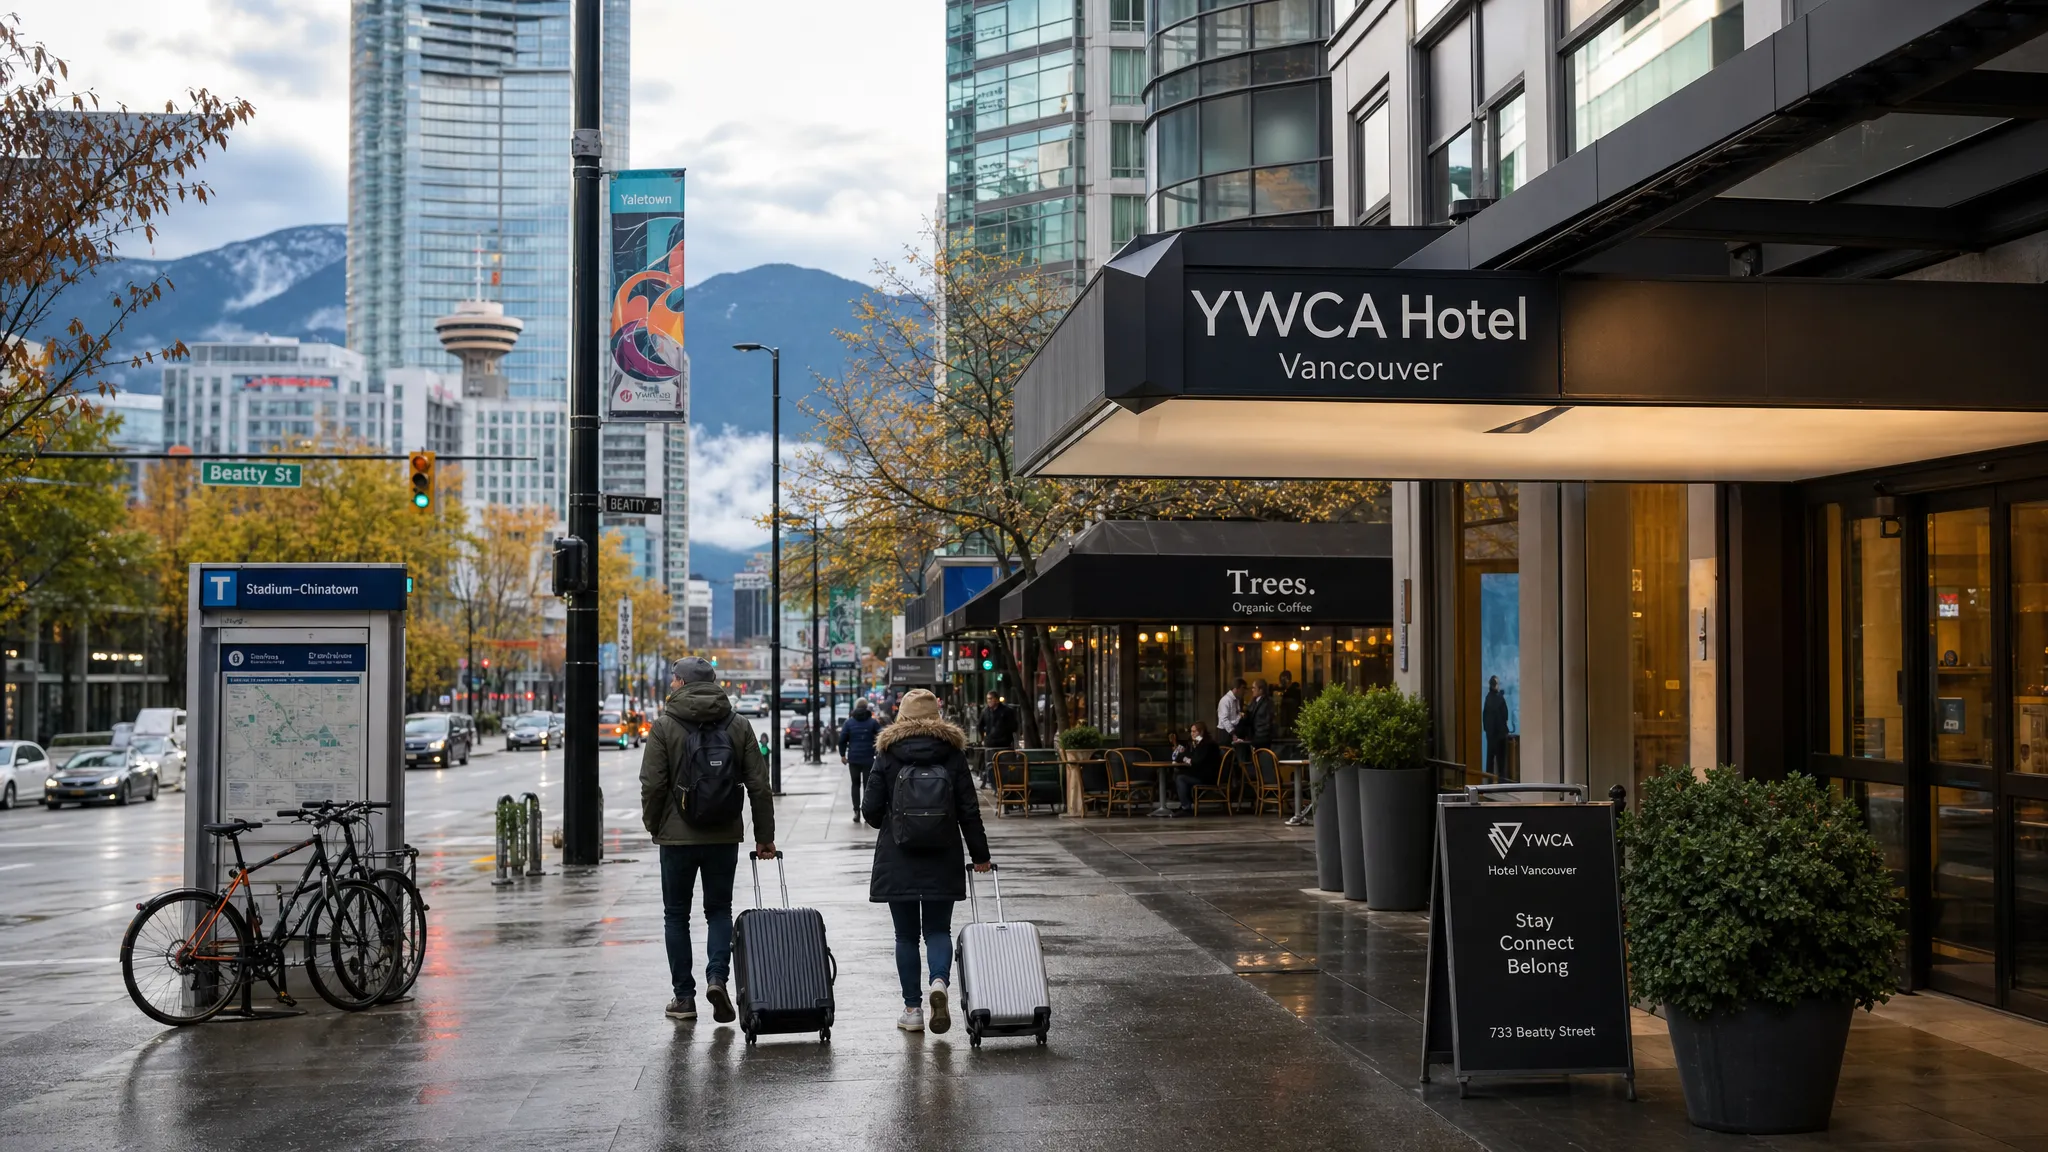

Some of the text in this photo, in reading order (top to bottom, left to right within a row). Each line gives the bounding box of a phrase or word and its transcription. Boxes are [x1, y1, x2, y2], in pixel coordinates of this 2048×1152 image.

[620, 193, 672, 205] Yaletown
[1190, 290, 1527, 341] YWCA Hotel
[1278, 352, 1443, 381] Vancouver
[210, 465, 292, 485] Beatty St
[611, 498, 647, 511] BEATTY
[210, 576, 231, 601] T
[1226, 569, 1315, 595] Trees.
[1232, 601, 1312, 615] Organic Coffee
[1522, 833, 1574, 847] YWCA
[1488, 865, 1577, 876] Hotel Vancouver
[1516, 912, 1554, 932] Stay
[1499, 935, 1575, 951] Connect
[1507, 957, 1569, 978] Belong
[1489, 1025, 1596, 1040] 733 Beatty Street
